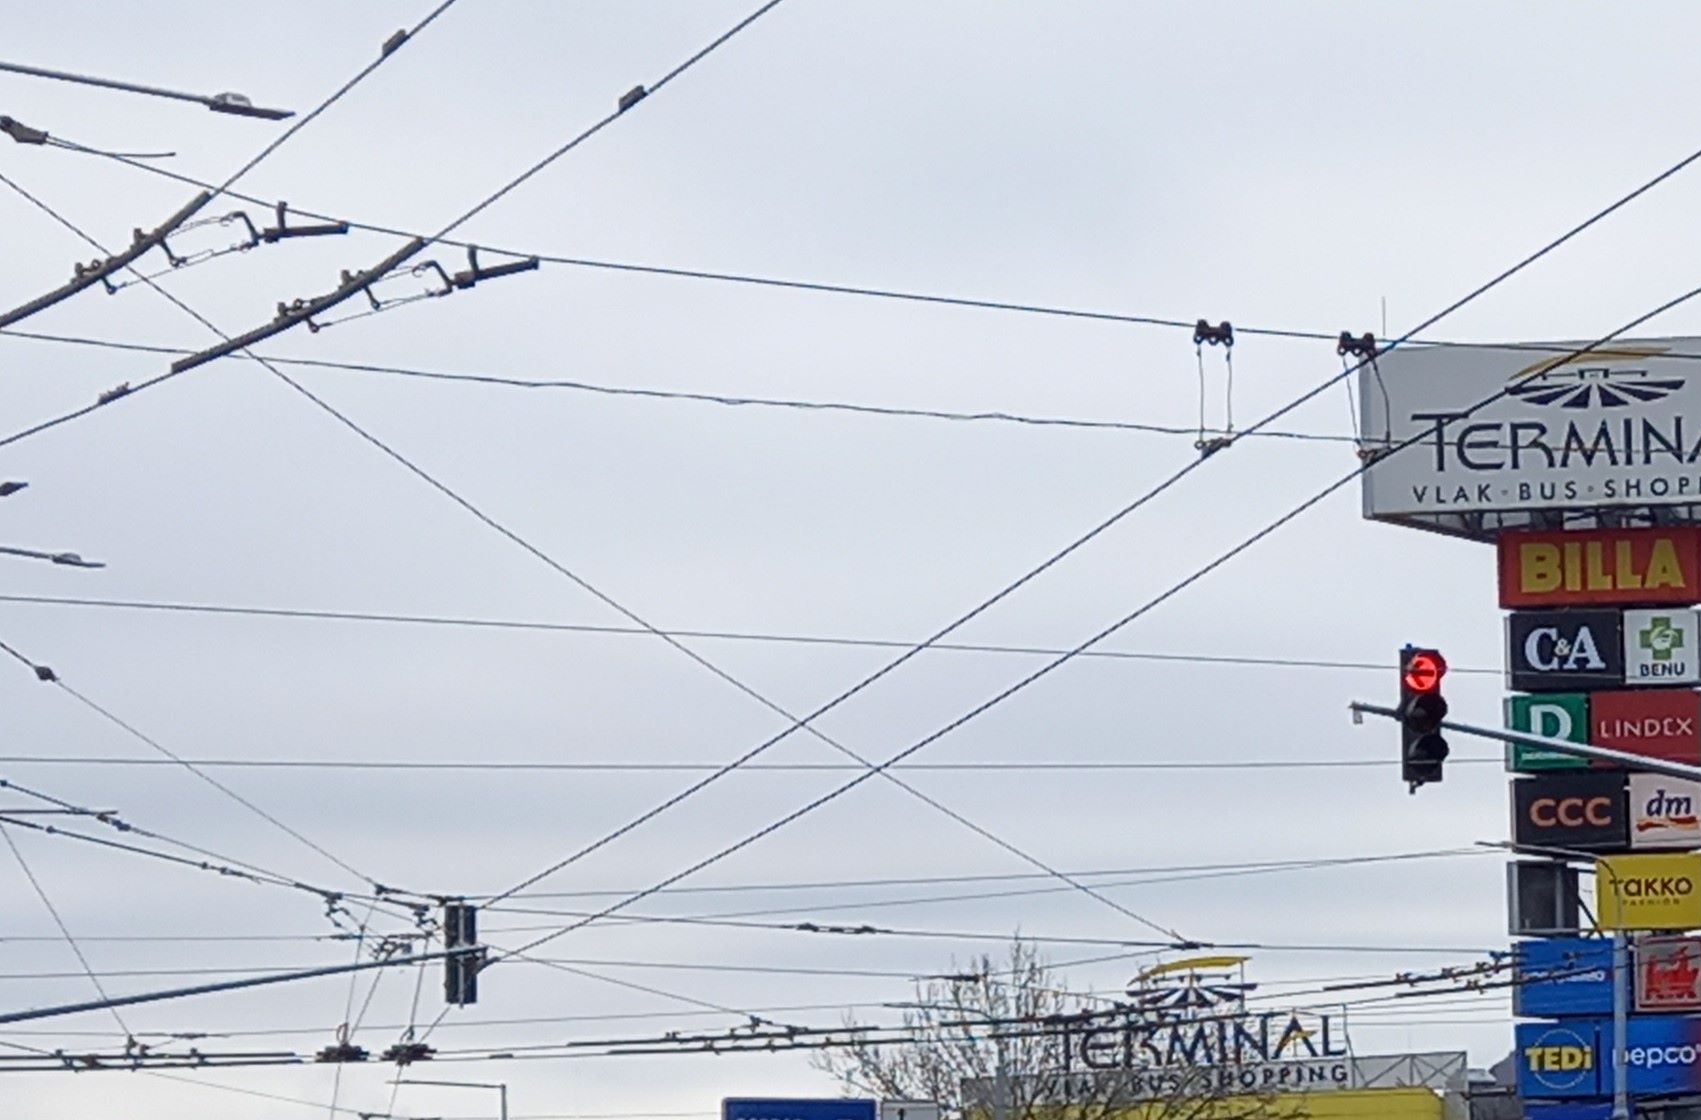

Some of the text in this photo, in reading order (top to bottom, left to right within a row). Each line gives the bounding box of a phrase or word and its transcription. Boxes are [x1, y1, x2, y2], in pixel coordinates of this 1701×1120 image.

[1412, 484, 1493, 504] VLAK
[1518, 480, 1578, 501] BUS
[1520, 538, 1686, 594] BILLA
[1525, 626, 1606, 671] C&A
[1640, 662, 1685, 677] BENU
[1600, 716, 1693, 739] LINDEX
[1529, 797, 1612, 827] CCC
[1646, 789, 1691, 816] dm
[1525, 1045, 1593, 1072] TEDi
